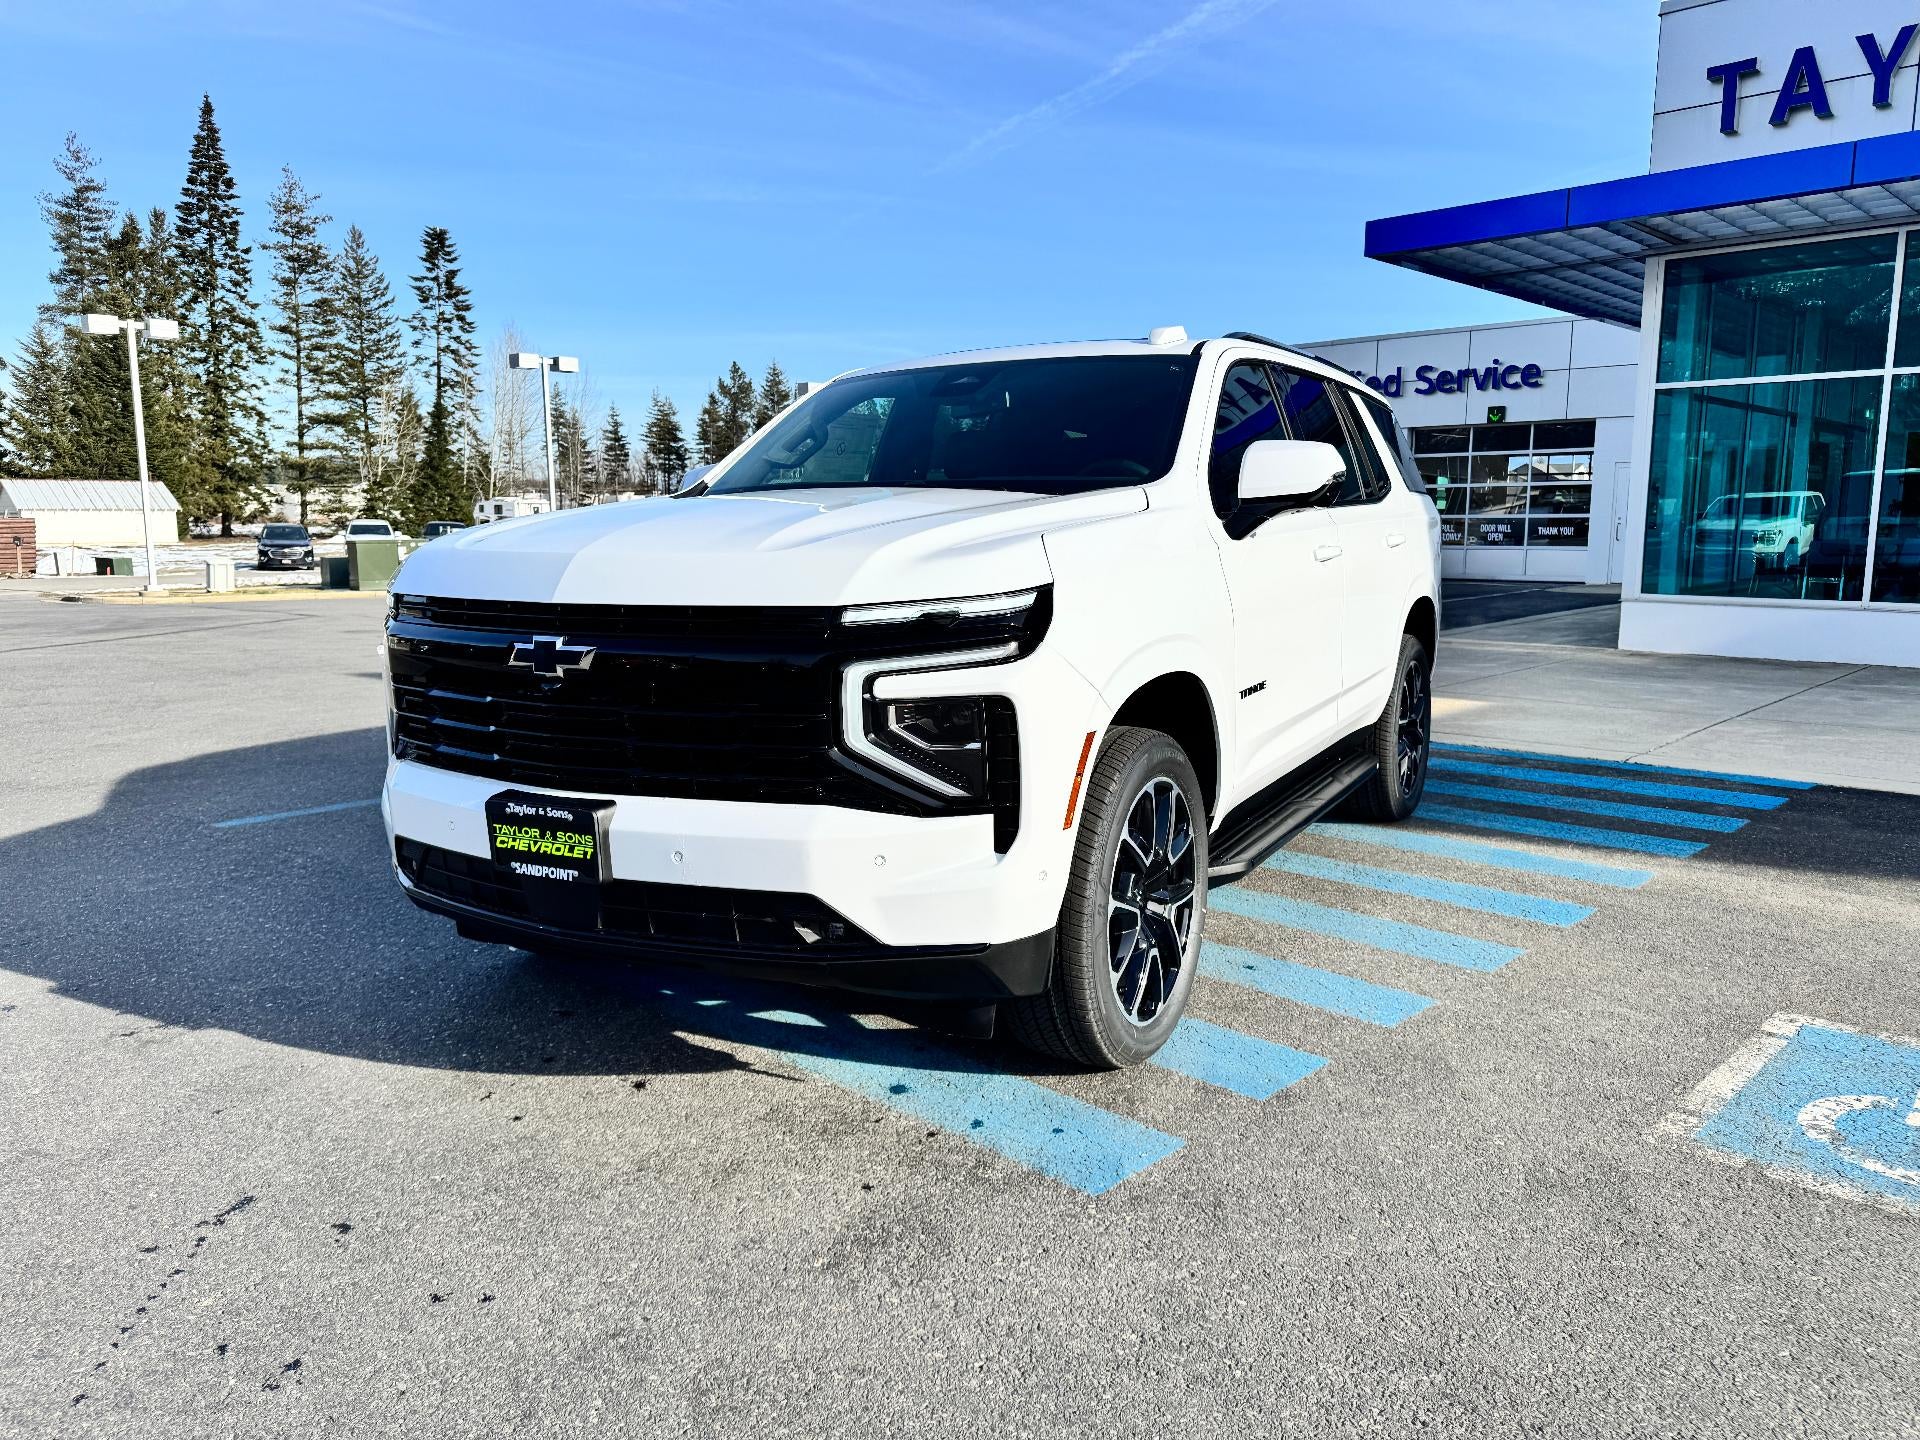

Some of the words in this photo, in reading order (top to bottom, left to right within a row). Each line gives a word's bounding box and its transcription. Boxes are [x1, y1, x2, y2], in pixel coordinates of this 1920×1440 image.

[1707, 23, 1920, 135] TAY
[1414, 358, 1543, 395] Service
[1441, 532, 1462, 541] LOWLY
[1480, 524, 1497, 533] DOOR
[1498, 524, 1512, 533] WILL
[1487, 532, 1504, 542] OPEN
[1538, 526, 1559, 536] THANK
[1560, 527, 1575, 536] YOU!
[507, 802, 537, 817] Taylor
[546, 807, 569, 819] Sons
[493, 824, 540, 839] TAYLOR
[544, 830, 553, 843] &
[556, 831, 594, 846] SONS
[496, 836, 594, 860] CHEVROLET
[515, 862, 574, 882] SANDPOINT
